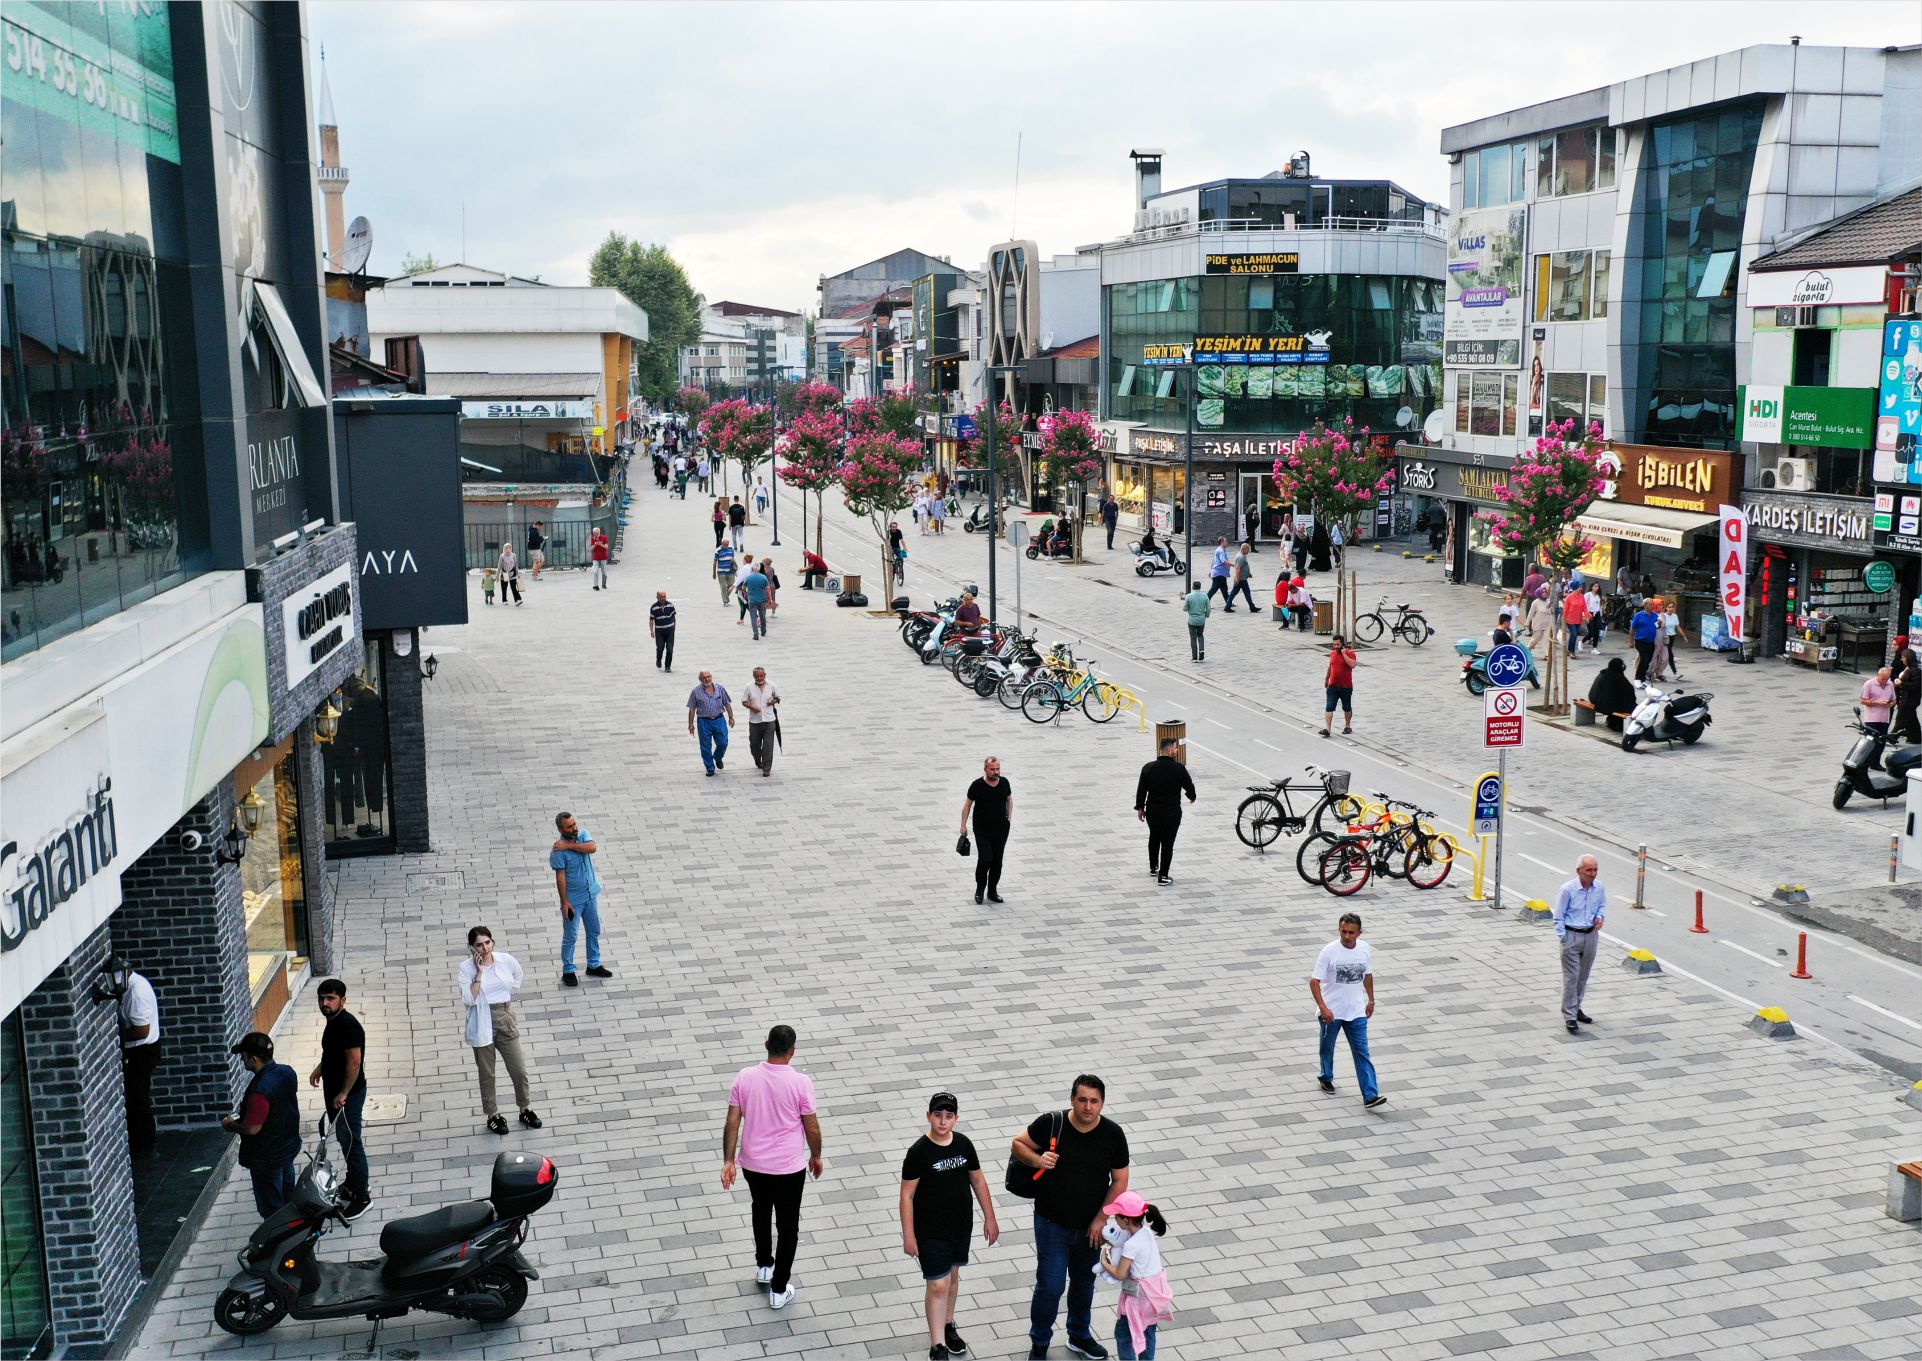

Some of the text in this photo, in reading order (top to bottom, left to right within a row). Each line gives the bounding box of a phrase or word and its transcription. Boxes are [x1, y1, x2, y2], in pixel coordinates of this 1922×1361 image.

[5, 16, 46, 82] 514
[1231, 257, 1242, 265] ve
[1243, 254, 1298, 265] LAHMACUN
[1229, 265, 1274, 273] SALONU
[1806, 281, 1830, 292] bulut
[1464, 290, 1503, 304] AVANTAJLAR
[1793, 292, 1826, 304] sigorta
[1268, 334, 1305, 351] YERİ
[1457, 341, 1471, 353] BİLGİ
[1446, 354, 1457, 363] +90
[1457, 354, 1467, 363] 535
[1468, 354, 1478, 363] 961
[1486, 353, 1495, 363] 09
[1749, 400, 1778, 418] HDI
[1790, 410, 1817, 421] Acentesi
[1748, 419, 1777, 429] SİGORTA
[1403, 463, 1436, 489] STORKS
[256, 484, 286, 514] MERKEZİ
[1743, 503, 1867, 540] KARDEŞ İLETİŞİM
[1489, 728, 1519, 736] ARAÇLAR
[0, 775, 118, 951] Garanti
